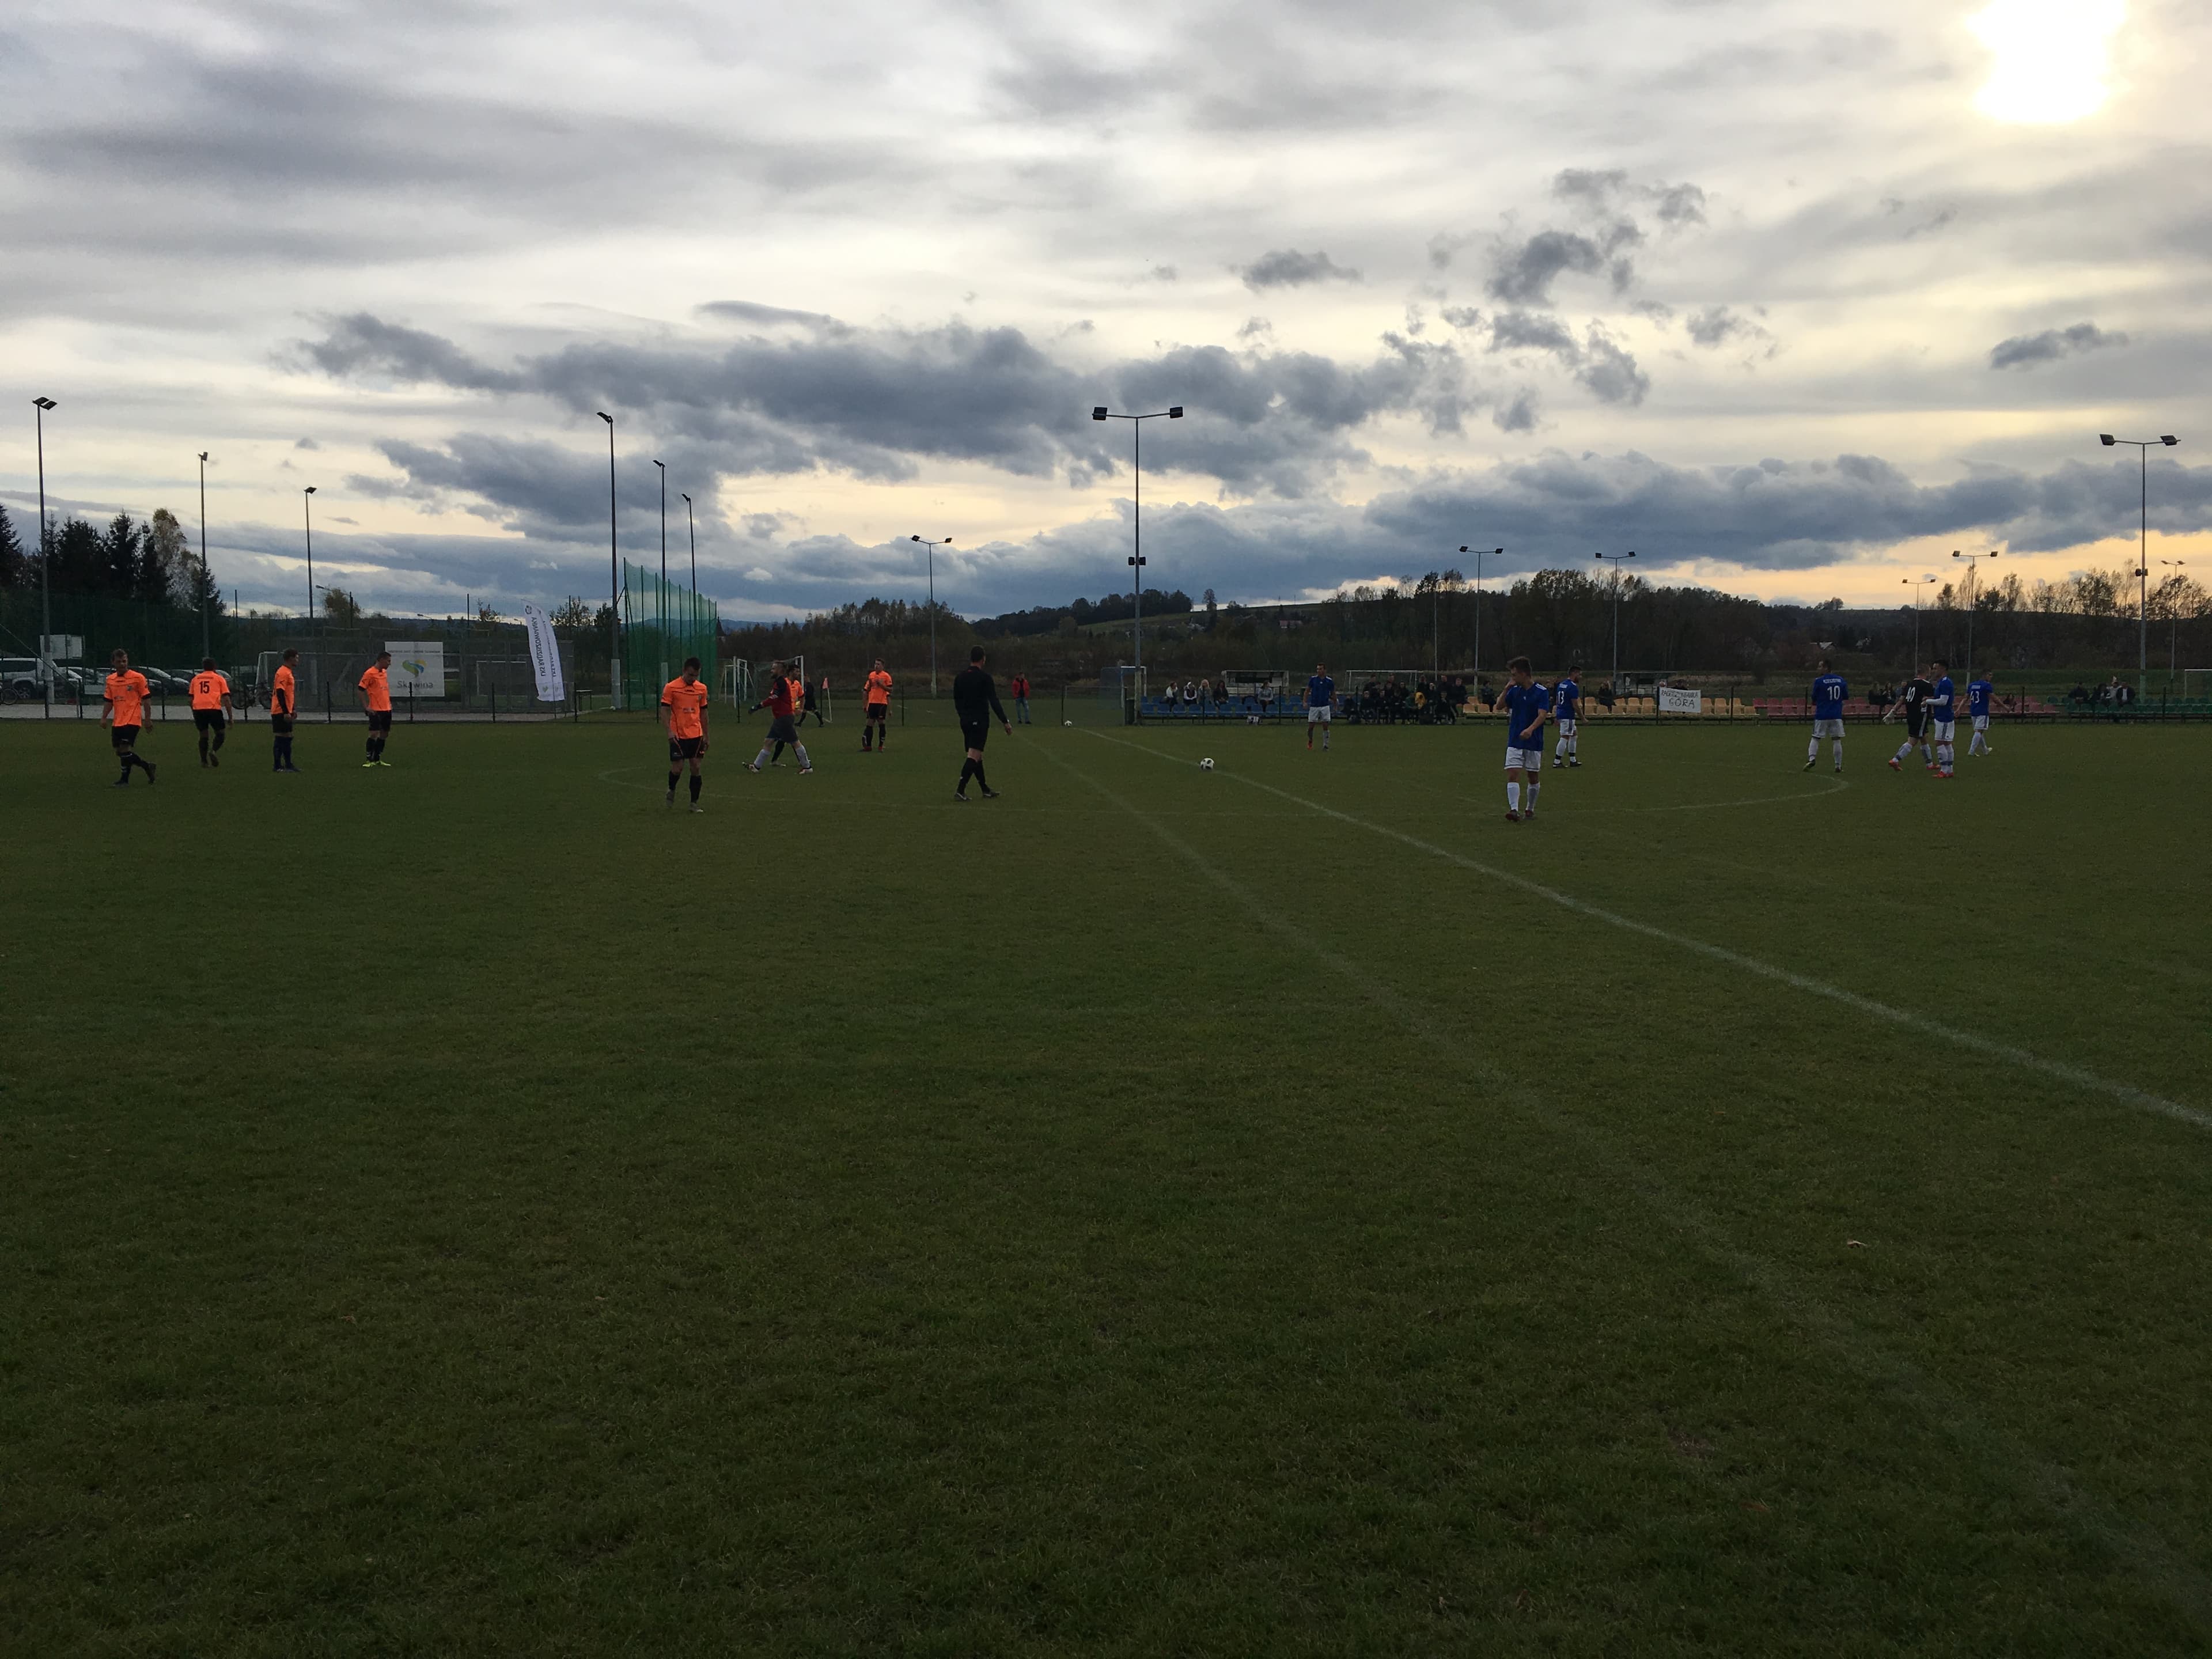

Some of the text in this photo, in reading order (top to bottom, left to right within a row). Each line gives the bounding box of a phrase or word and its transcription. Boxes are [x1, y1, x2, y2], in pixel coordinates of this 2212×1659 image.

[199, 681, 210, 694] 15
[1827, 685, 1840, 700] 10
[1558, 691, 1565, 704] 13
